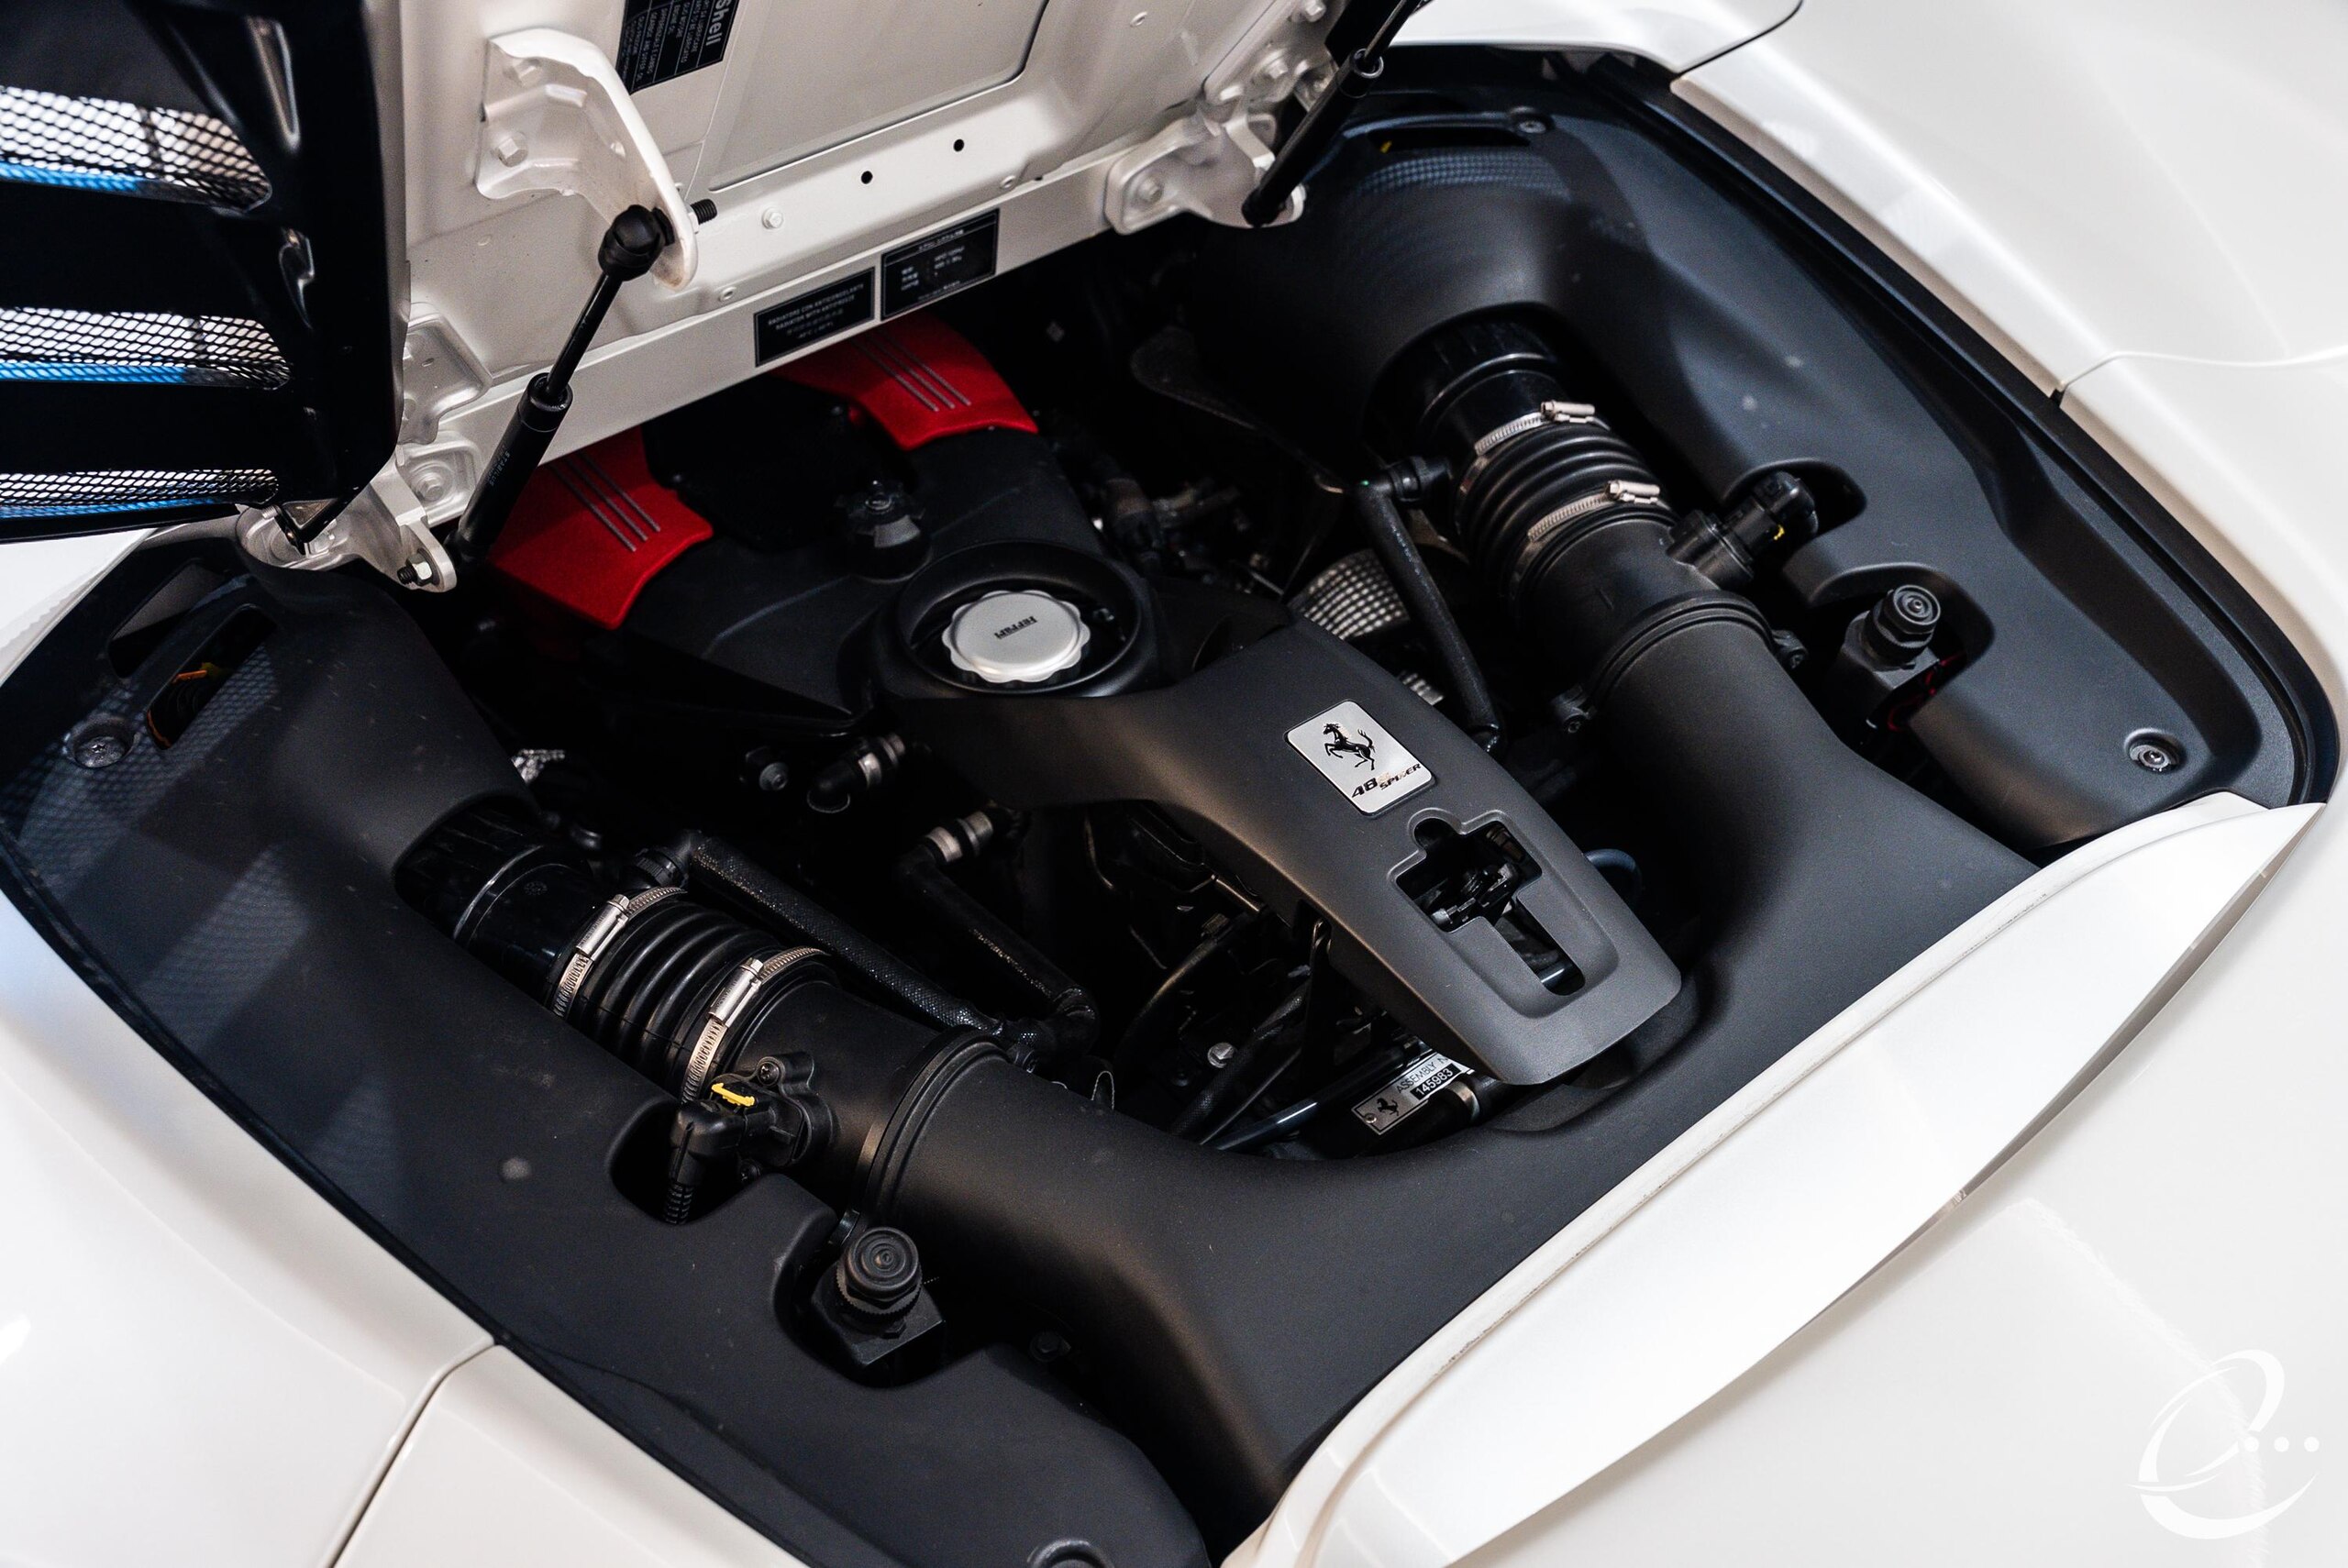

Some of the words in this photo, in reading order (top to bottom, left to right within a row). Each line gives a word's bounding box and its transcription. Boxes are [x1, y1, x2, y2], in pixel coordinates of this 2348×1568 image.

[706, 0, 731, 46] Shell
[993, 616, 1038, 640] Ferrari
[1352, 772, 1390, 798] 48
[1396, 1061, 1437, 1094] ASSEMBLY
[1415, 1067, 1454, 1096] 145983
